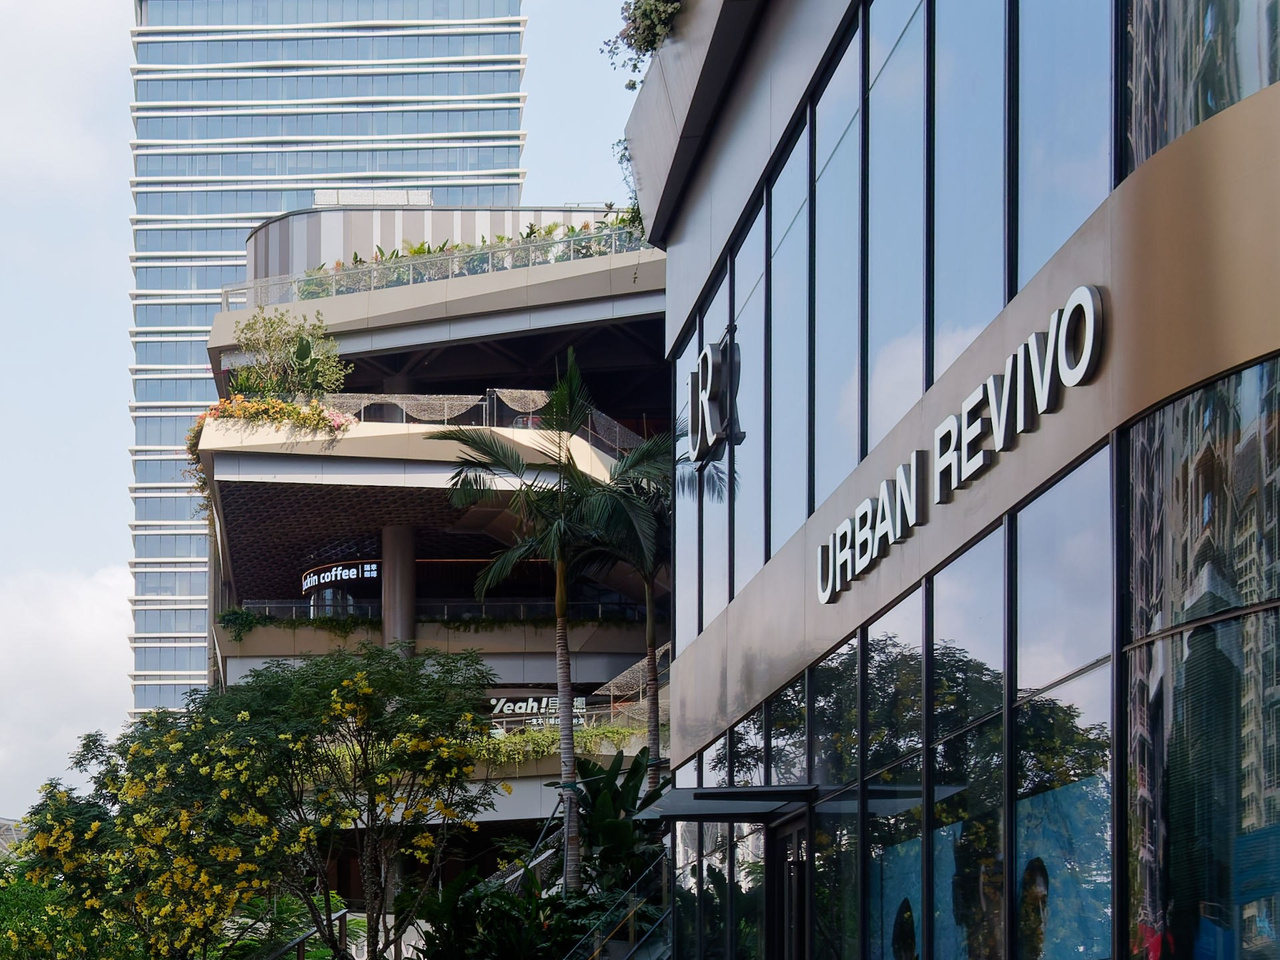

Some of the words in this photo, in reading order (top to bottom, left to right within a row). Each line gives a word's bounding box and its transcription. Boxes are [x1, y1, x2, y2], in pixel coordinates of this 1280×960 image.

[686, 343, 722, 462] UR
[817, 450, 926, 605] URBAN
[934, 284, 1103, 505] REVIVO
[320, 567, 357, 584] coffee
[490, 697, 548, 714] Yeah!
